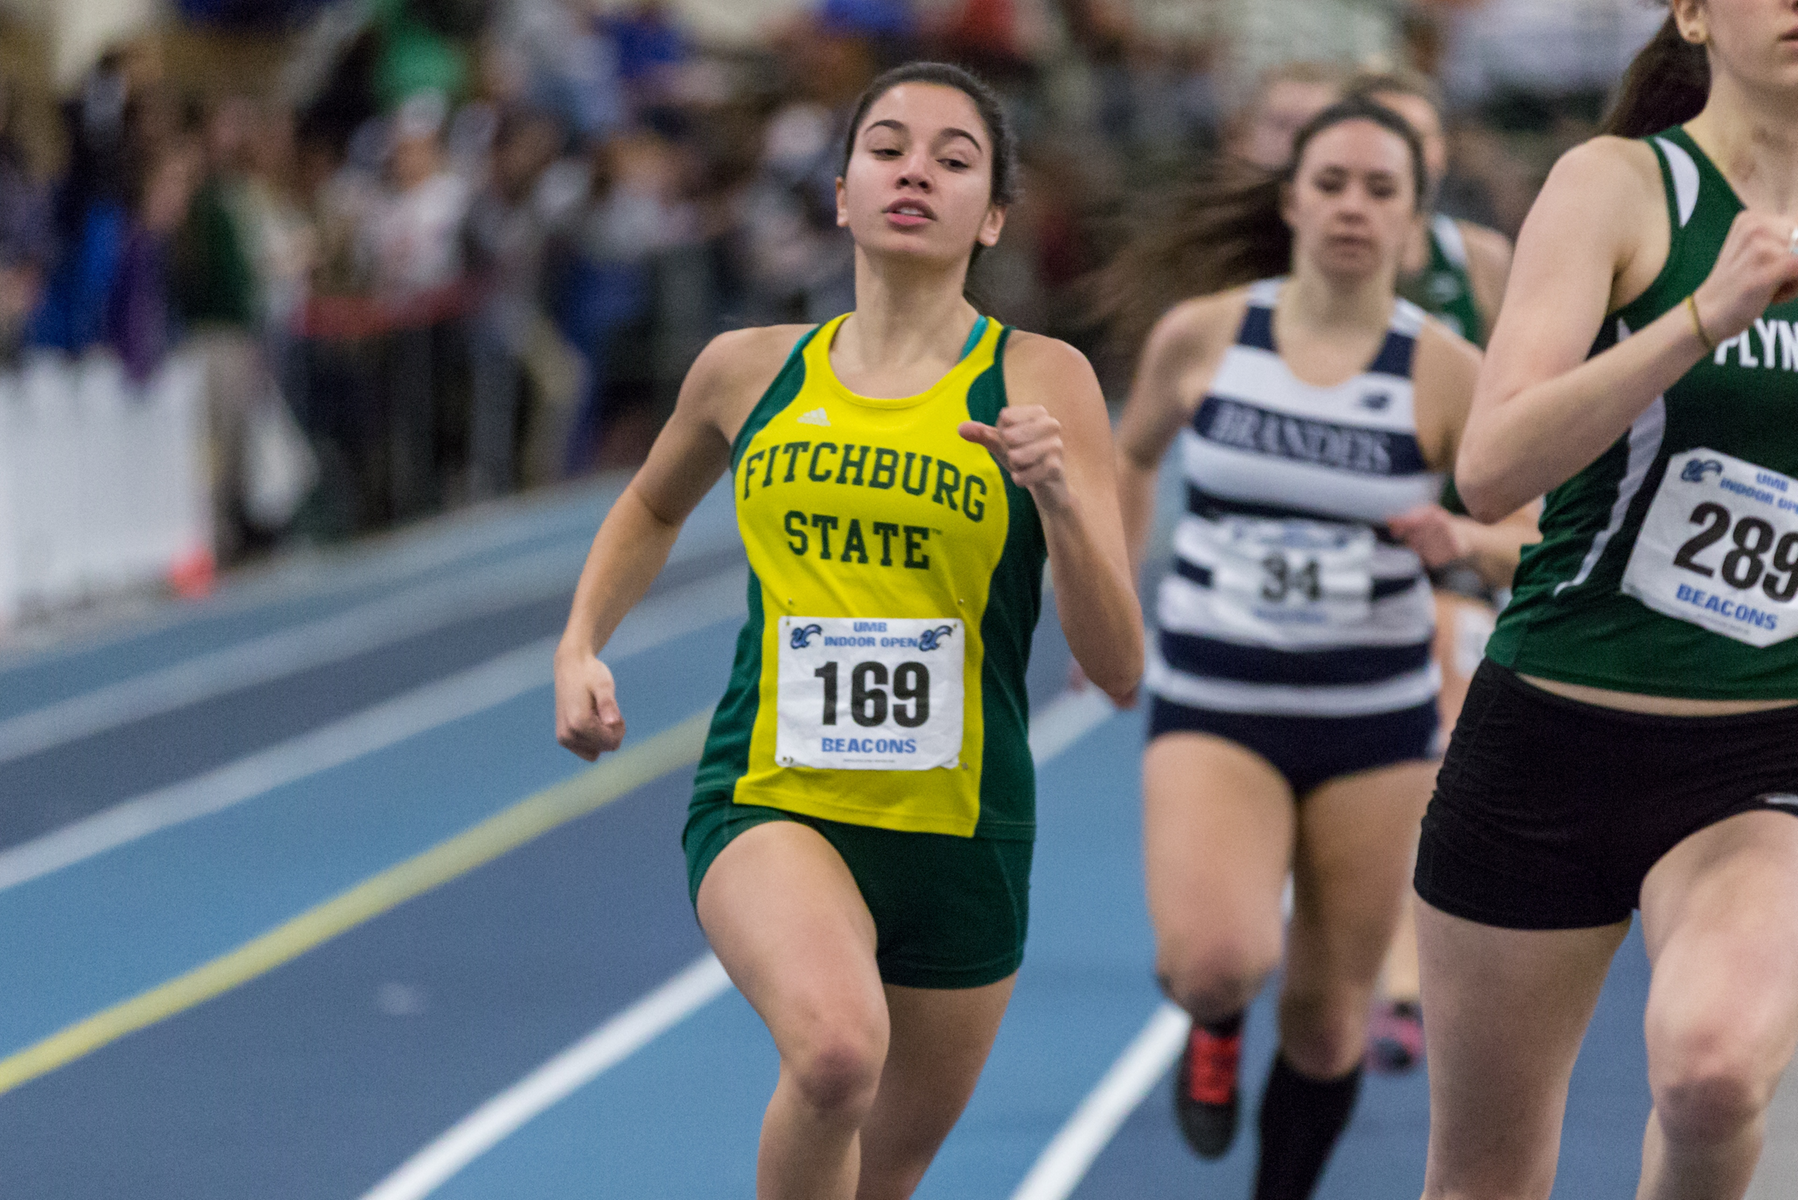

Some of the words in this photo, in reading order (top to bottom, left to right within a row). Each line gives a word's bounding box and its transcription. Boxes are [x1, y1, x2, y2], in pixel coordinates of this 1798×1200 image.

[744, 441, 987, 523] FITCHBURG
[784, 510, 929, 569] STATE
[1673, 501, 1798, 603] 289
[1261, 552, 1322, 601] 34
[853, 621, 888, 633] UMB
[1676, 583, 1778, 630] BEACONS
[824, 636, 876, 647] INDOOR
[881, 637, 918, 648] OPEN
[814, 661, 930, 728] 169
[821, 738, 917, 754] BEACONS
